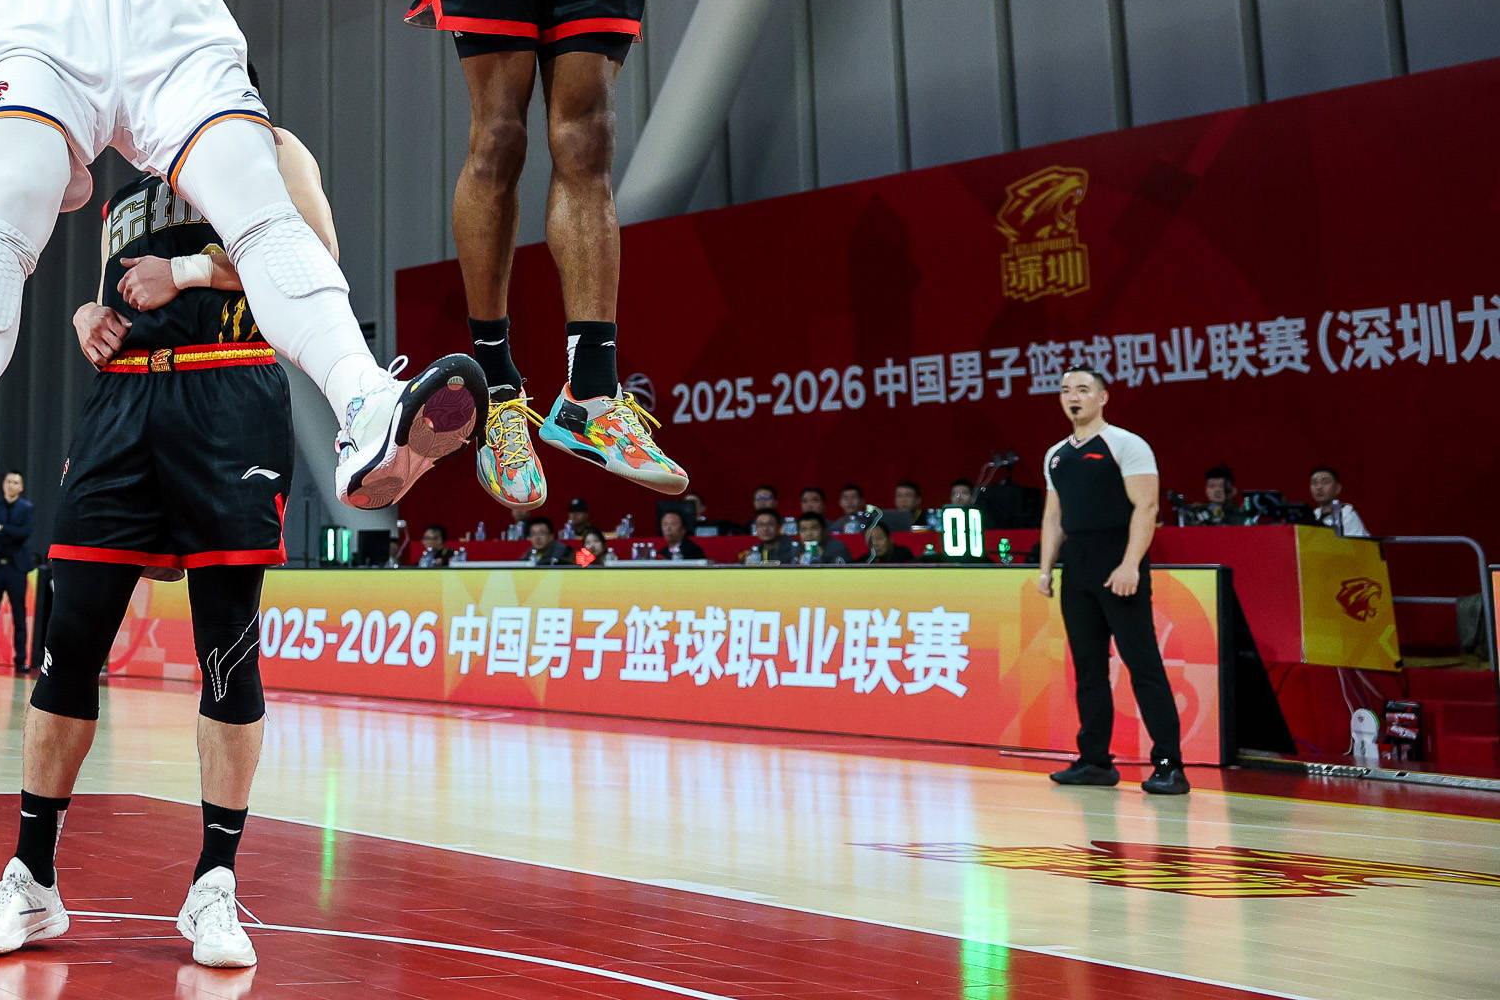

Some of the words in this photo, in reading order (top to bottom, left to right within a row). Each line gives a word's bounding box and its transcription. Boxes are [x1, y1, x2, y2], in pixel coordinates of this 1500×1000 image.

[671, 365, 866, 424] 2025-2026
[259, 606, 438, 668] 025-2026
[448, 603, 971, 698] 中国男子篮球职业联赛
